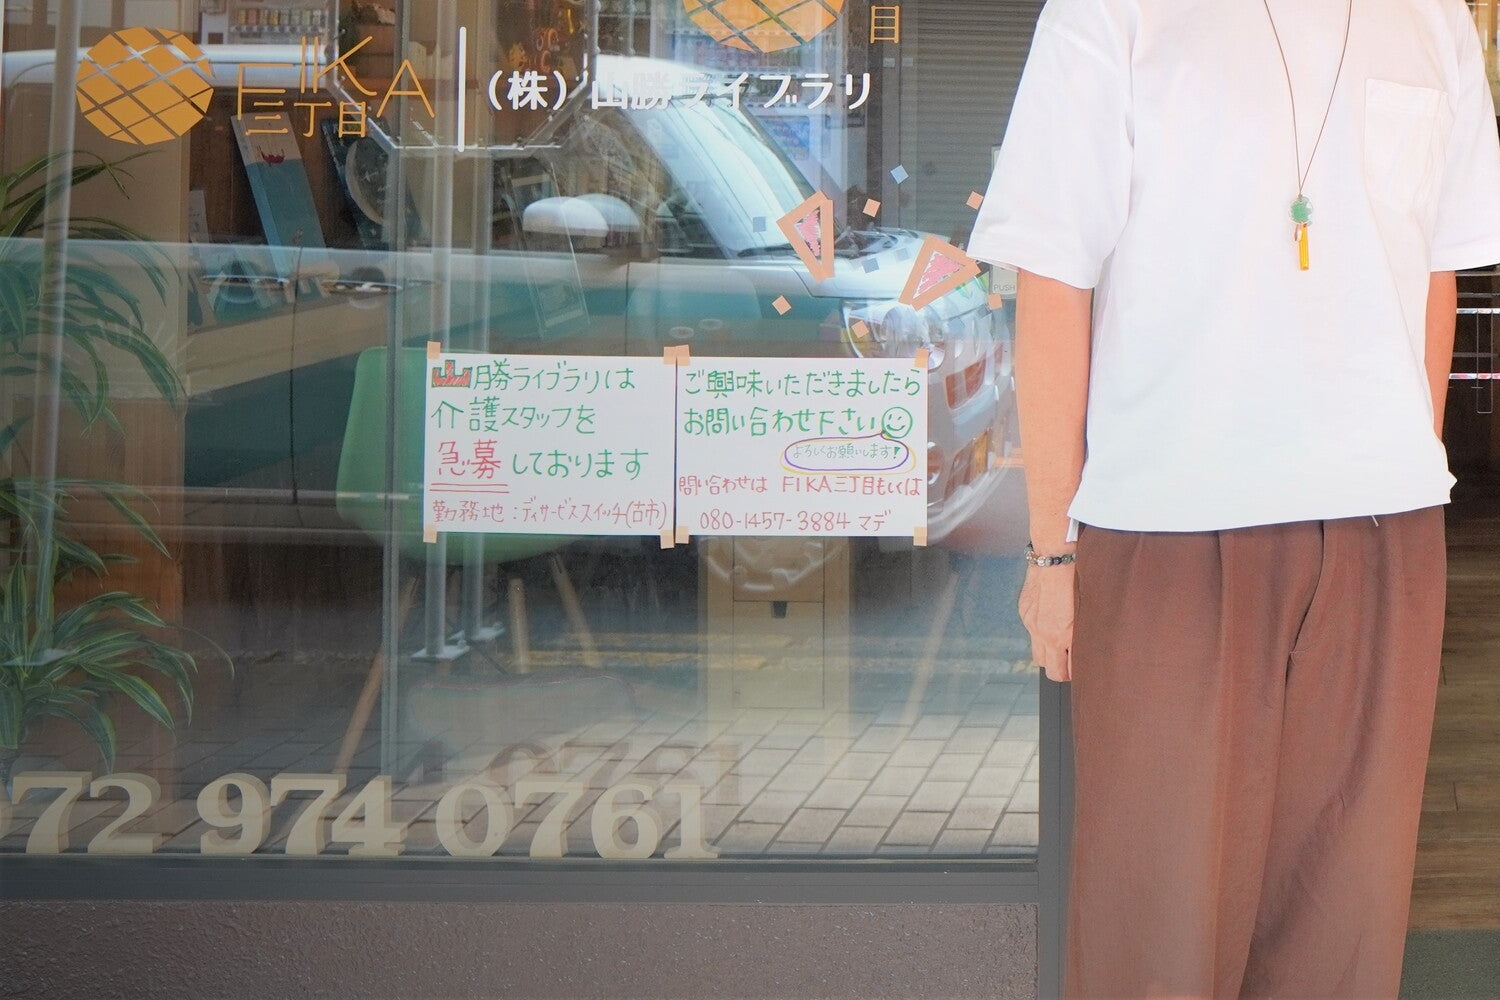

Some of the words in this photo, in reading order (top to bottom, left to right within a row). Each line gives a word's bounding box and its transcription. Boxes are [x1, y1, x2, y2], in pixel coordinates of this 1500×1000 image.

[236, 35, 435, 120] FIKA
[244, 100, 367, 138] 三丁目
[685, 368, 921, 399] ご興味いただきましたら
[431, 396, 597, 434] 介護スタッフを
[683, 406, 876, 437] お問い合わせ下さい
[0, 771, 164, 854] 72
[197, 772, 409, 856] 974
[436, 775, 722, 860] 0761
